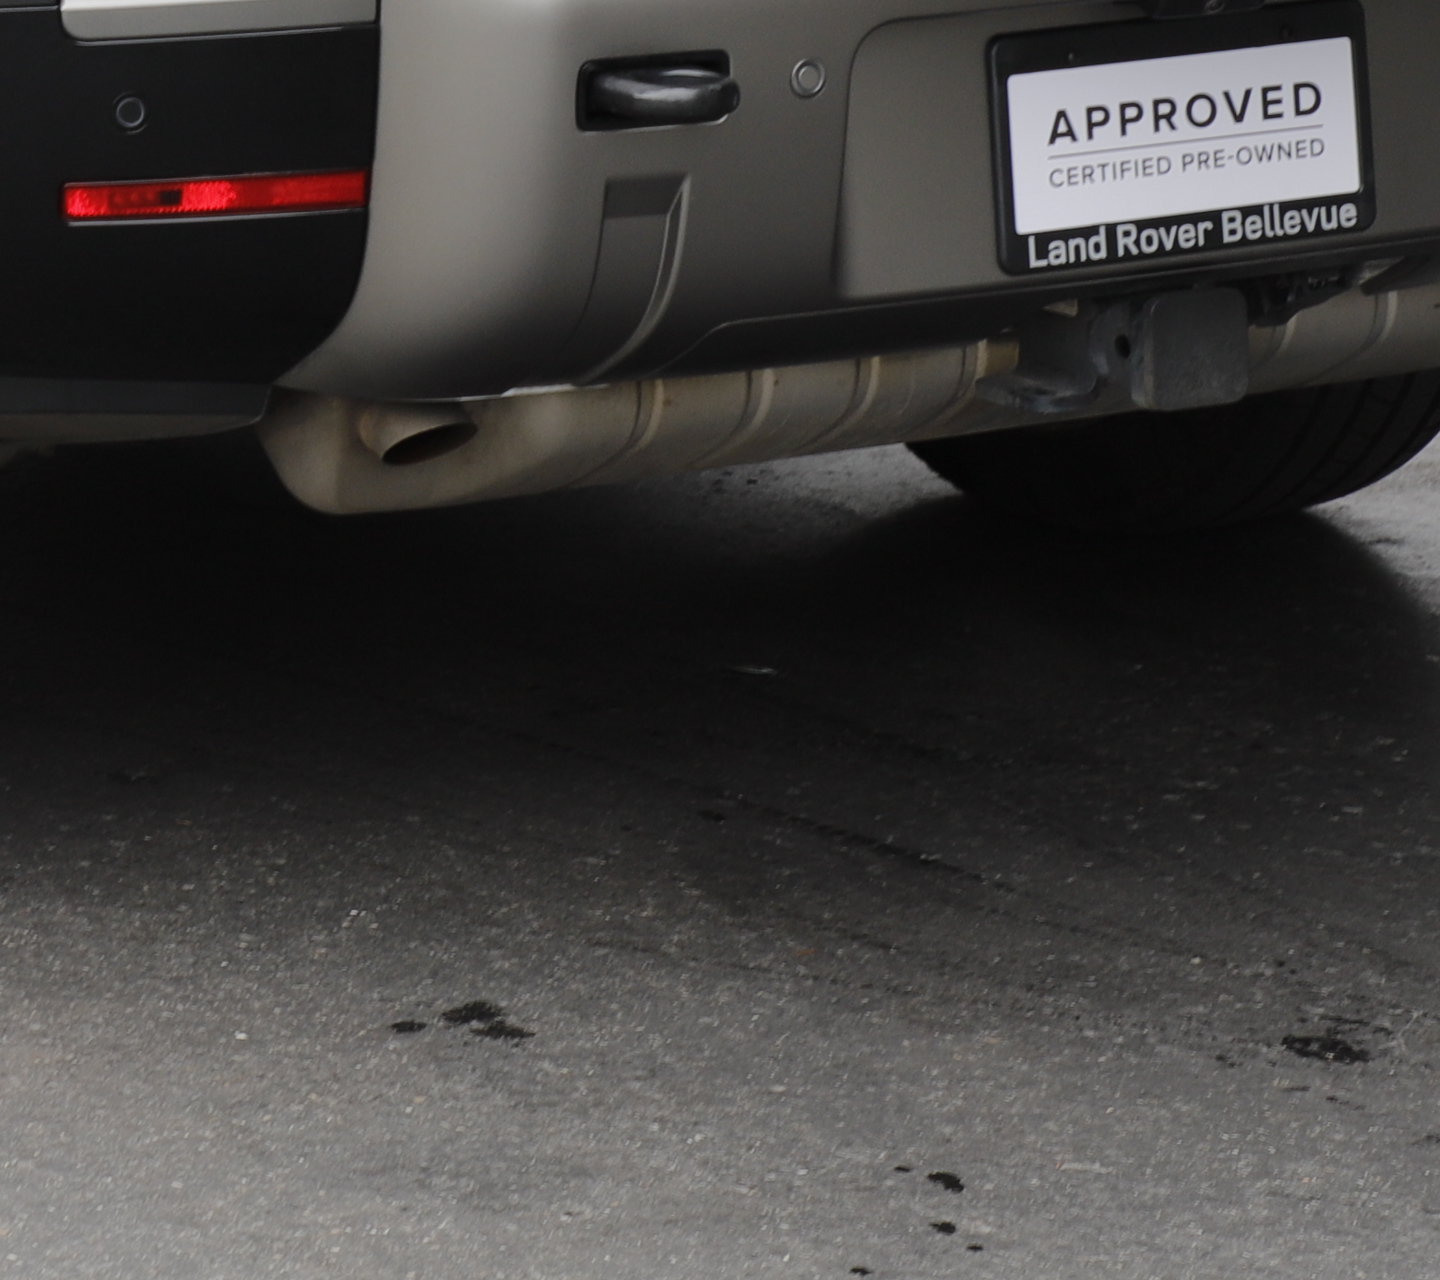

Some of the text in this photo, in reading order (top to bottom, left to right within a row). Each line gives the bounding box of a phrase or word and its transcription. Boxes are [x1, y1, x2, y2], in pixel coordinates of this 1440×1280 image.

[1047, 81, 1323, 146] APPROVED
[1049, 138, 1326, 188] CERTIFIED PRE-OWNED
[1028, 203, 1358, 269] Land Rover Bellevue
